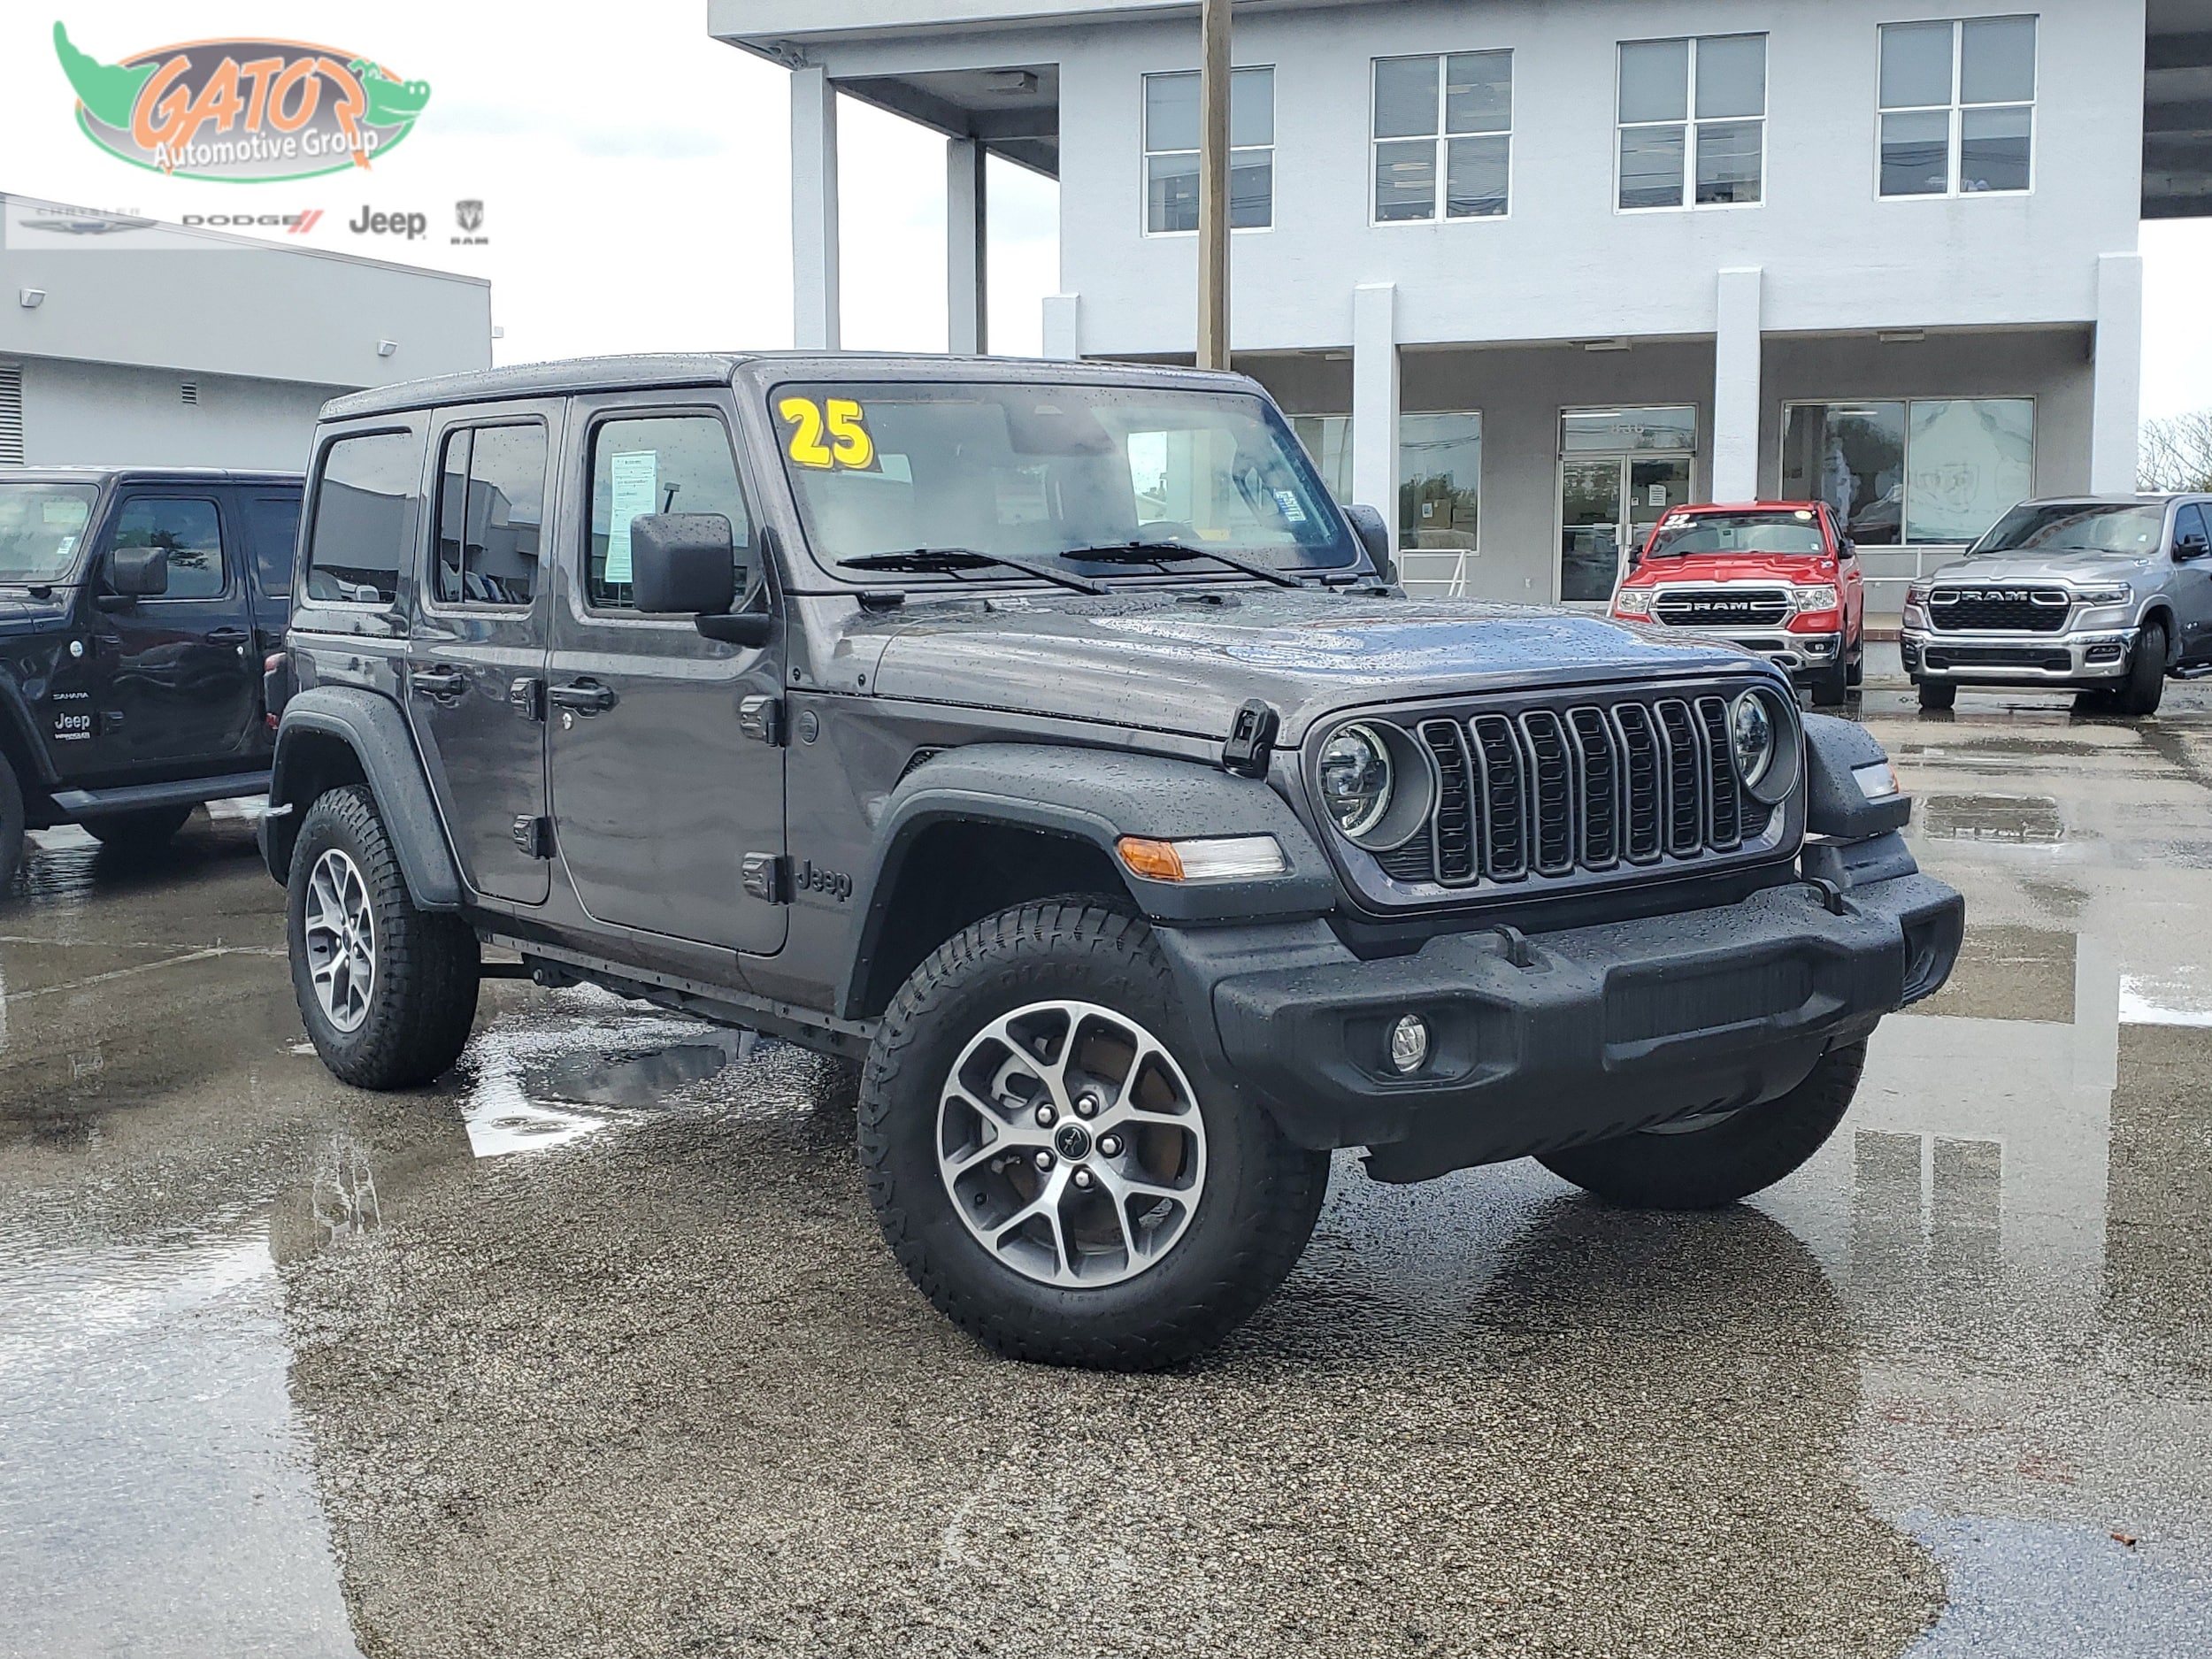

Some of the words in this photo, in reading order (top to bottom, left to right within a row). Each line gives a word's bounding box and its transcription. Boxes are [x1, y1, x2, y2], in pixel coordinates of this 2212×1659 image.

[779, 397, 874, 469] 25
[1664, 513, 1691, 526] 22
[1962, 590, 2028, 602] RAM
[1694, 602, 1749, 611] RAM
[54, 712, 90, 731] Jeep
[795, 859, 853, 902] Jeep
